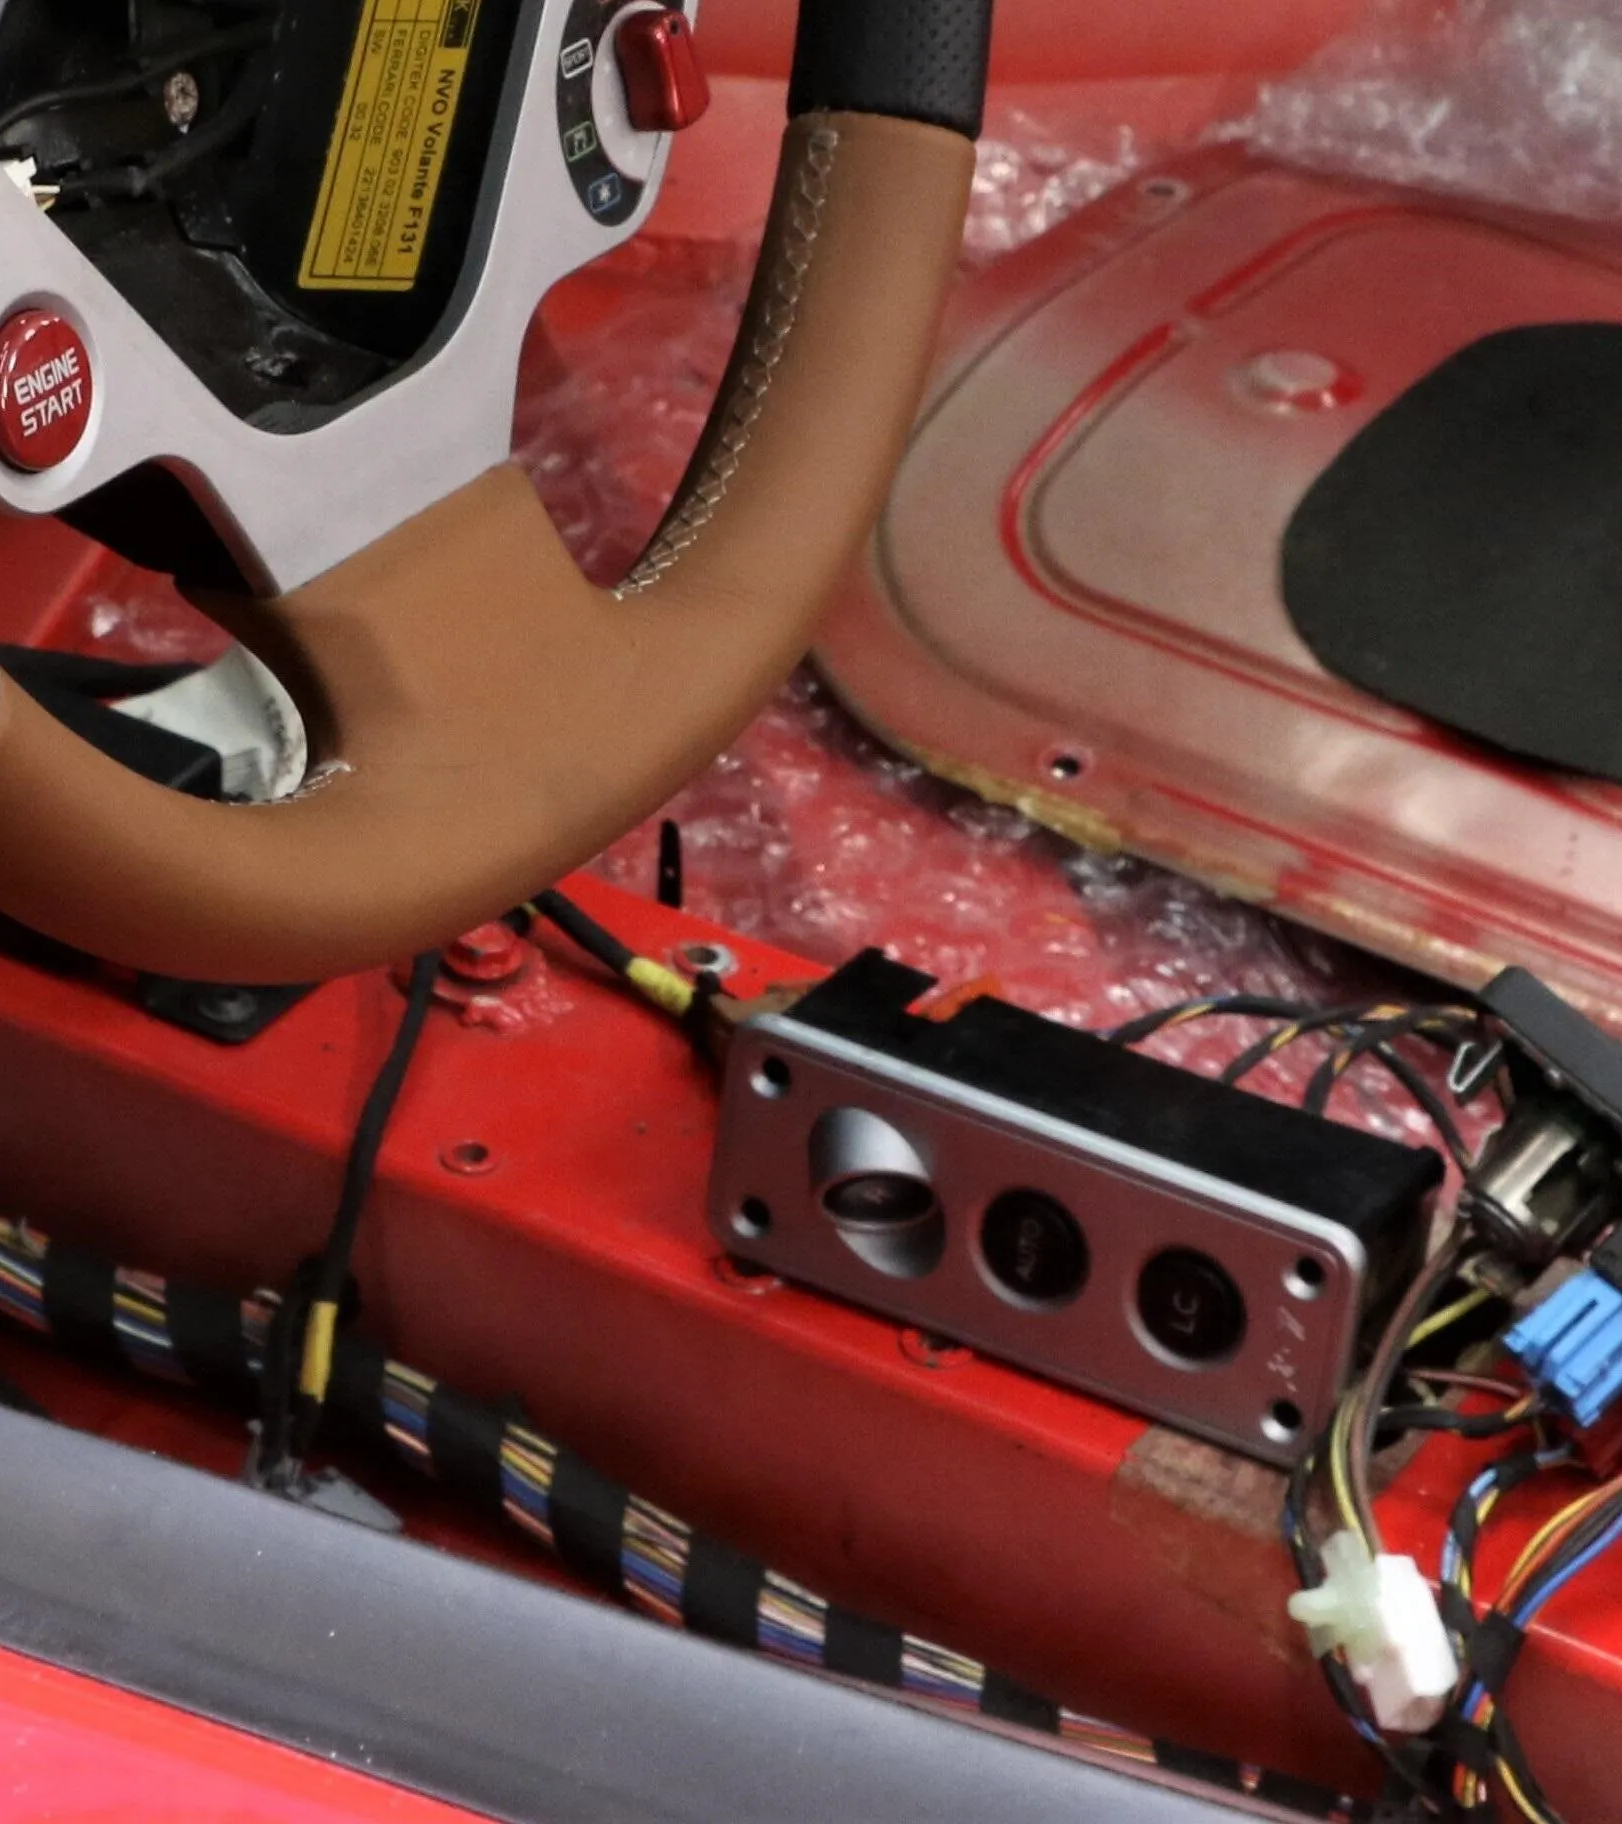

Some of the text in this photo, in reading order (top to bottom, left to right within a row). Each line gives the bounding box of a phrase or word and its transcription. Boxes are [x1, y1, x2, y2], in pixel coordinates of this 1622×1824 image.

[380, 30, 407, 97] FERRARI
[406, 30, 431, 89] DIGITEK
[394, 95, 415, 139] CODE
[429, 69, 455, 114] NVO
[368, 101, 390, 144] CODE
[409, 123, 443, 199] Volante
[396, 206, 423, 253] F131
[14, 347, 79, 405] ENGINE
[21, 378, 82, 436] START
[1171, 1290, 1198, 1334] LC
